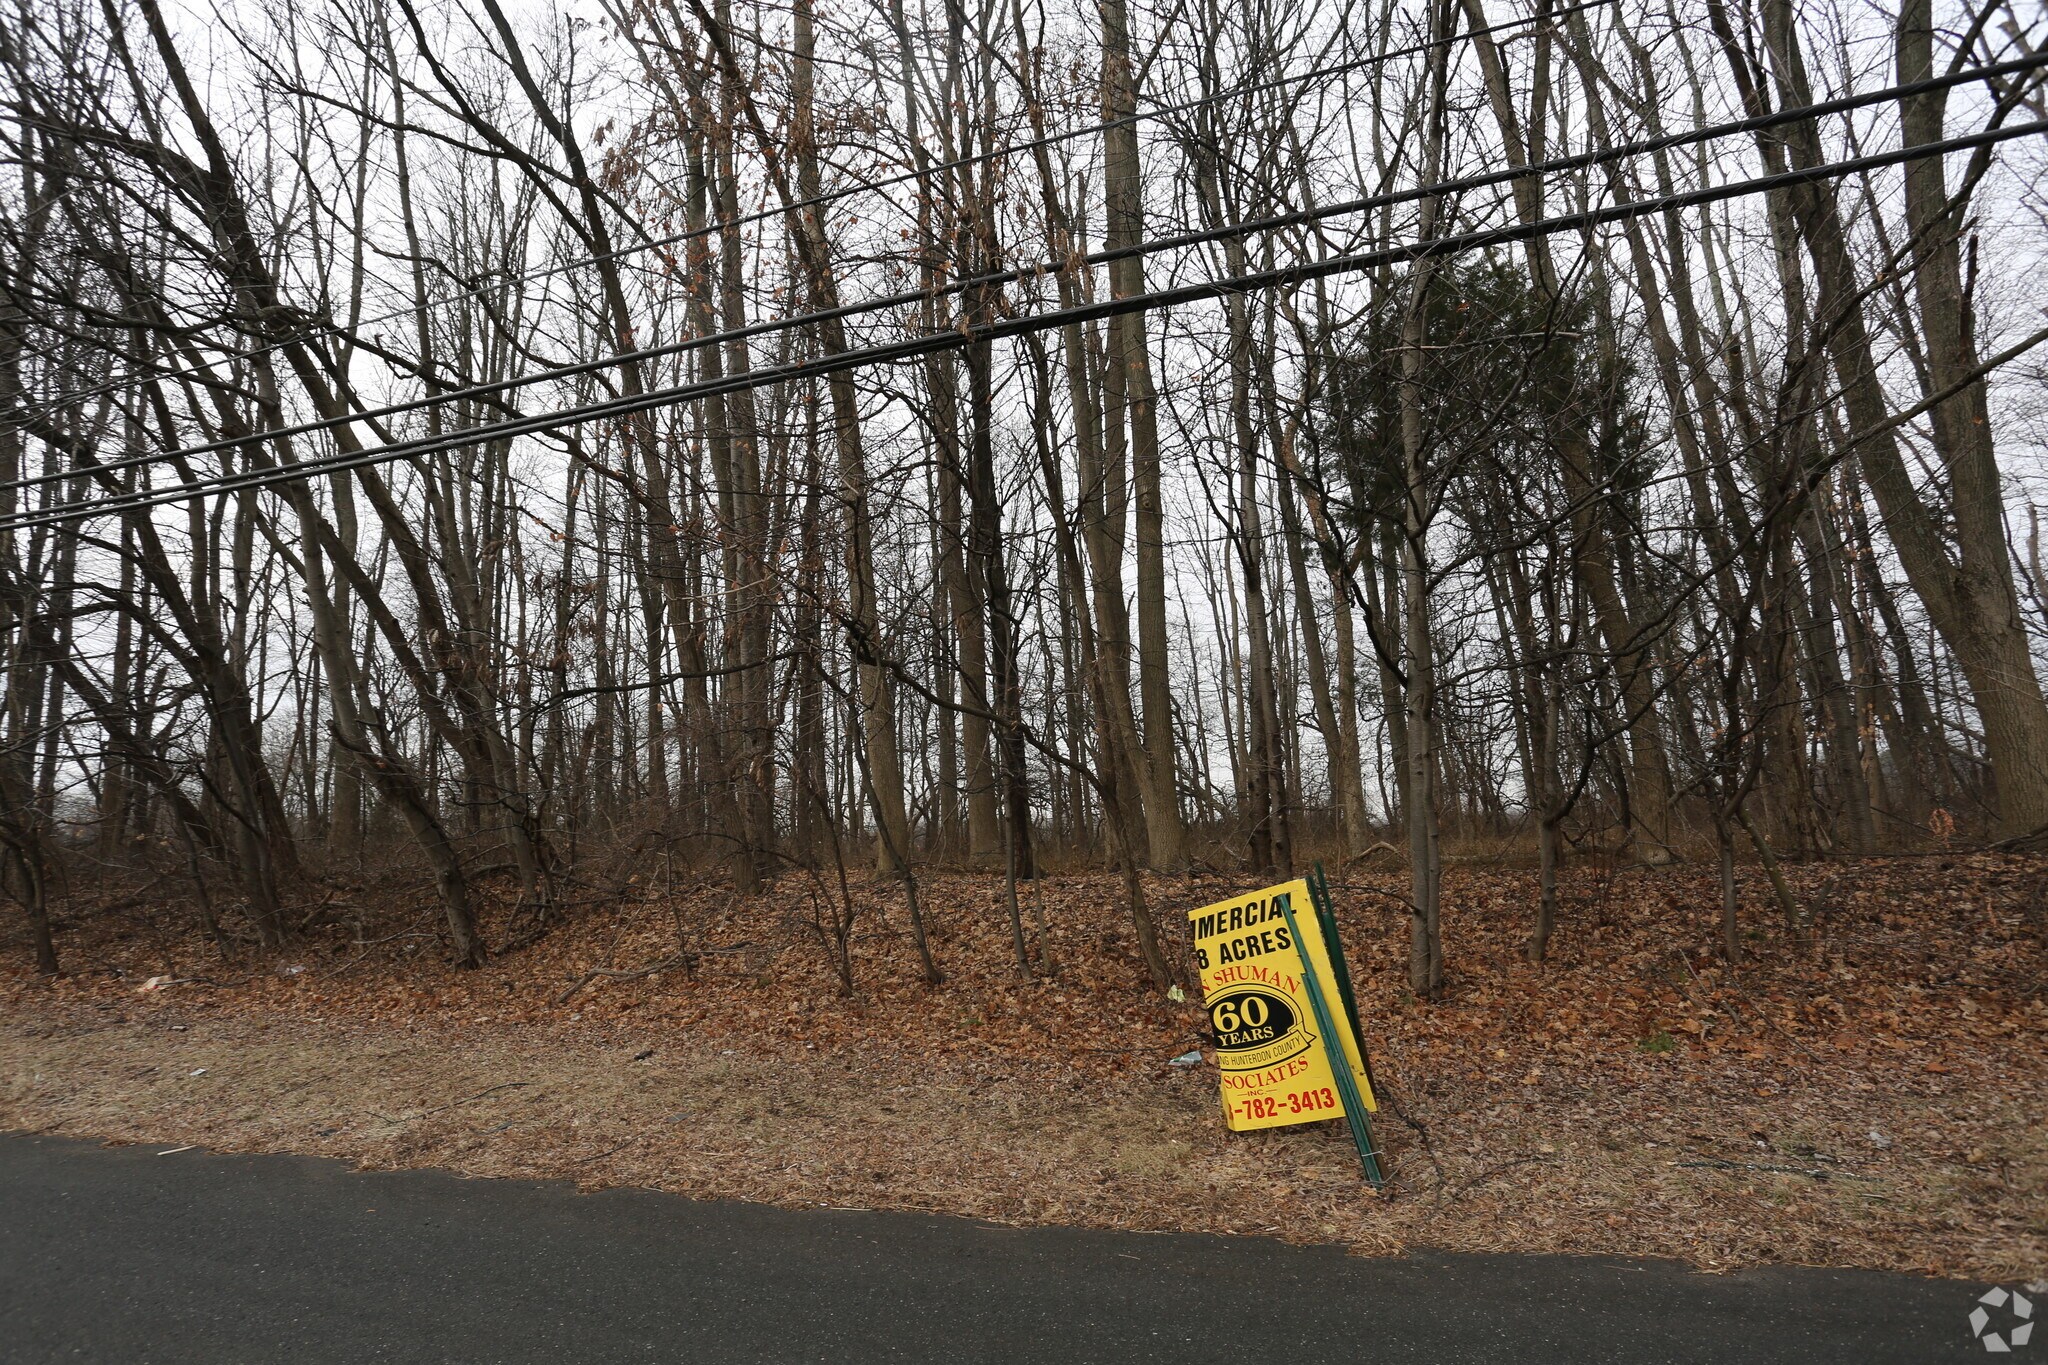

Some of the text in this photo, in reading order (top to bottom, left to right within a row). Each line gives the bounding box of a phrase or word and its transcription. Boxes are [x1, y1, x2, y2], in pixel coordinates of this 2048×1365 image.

[1219, 927, 1292, 965] ACRES
[1213, 965, 1301, 994] SHUMAN
[1213, 996, 1269, 1033] 60
[1218, 1026, 1275, 1047] YEARS
[1230, 1050, 1272, 1066] HUNTERDON
[1273, 1035, 1301, 1058] COUNTY
[1223, 1055, 1309, 1089] SOCIATES
